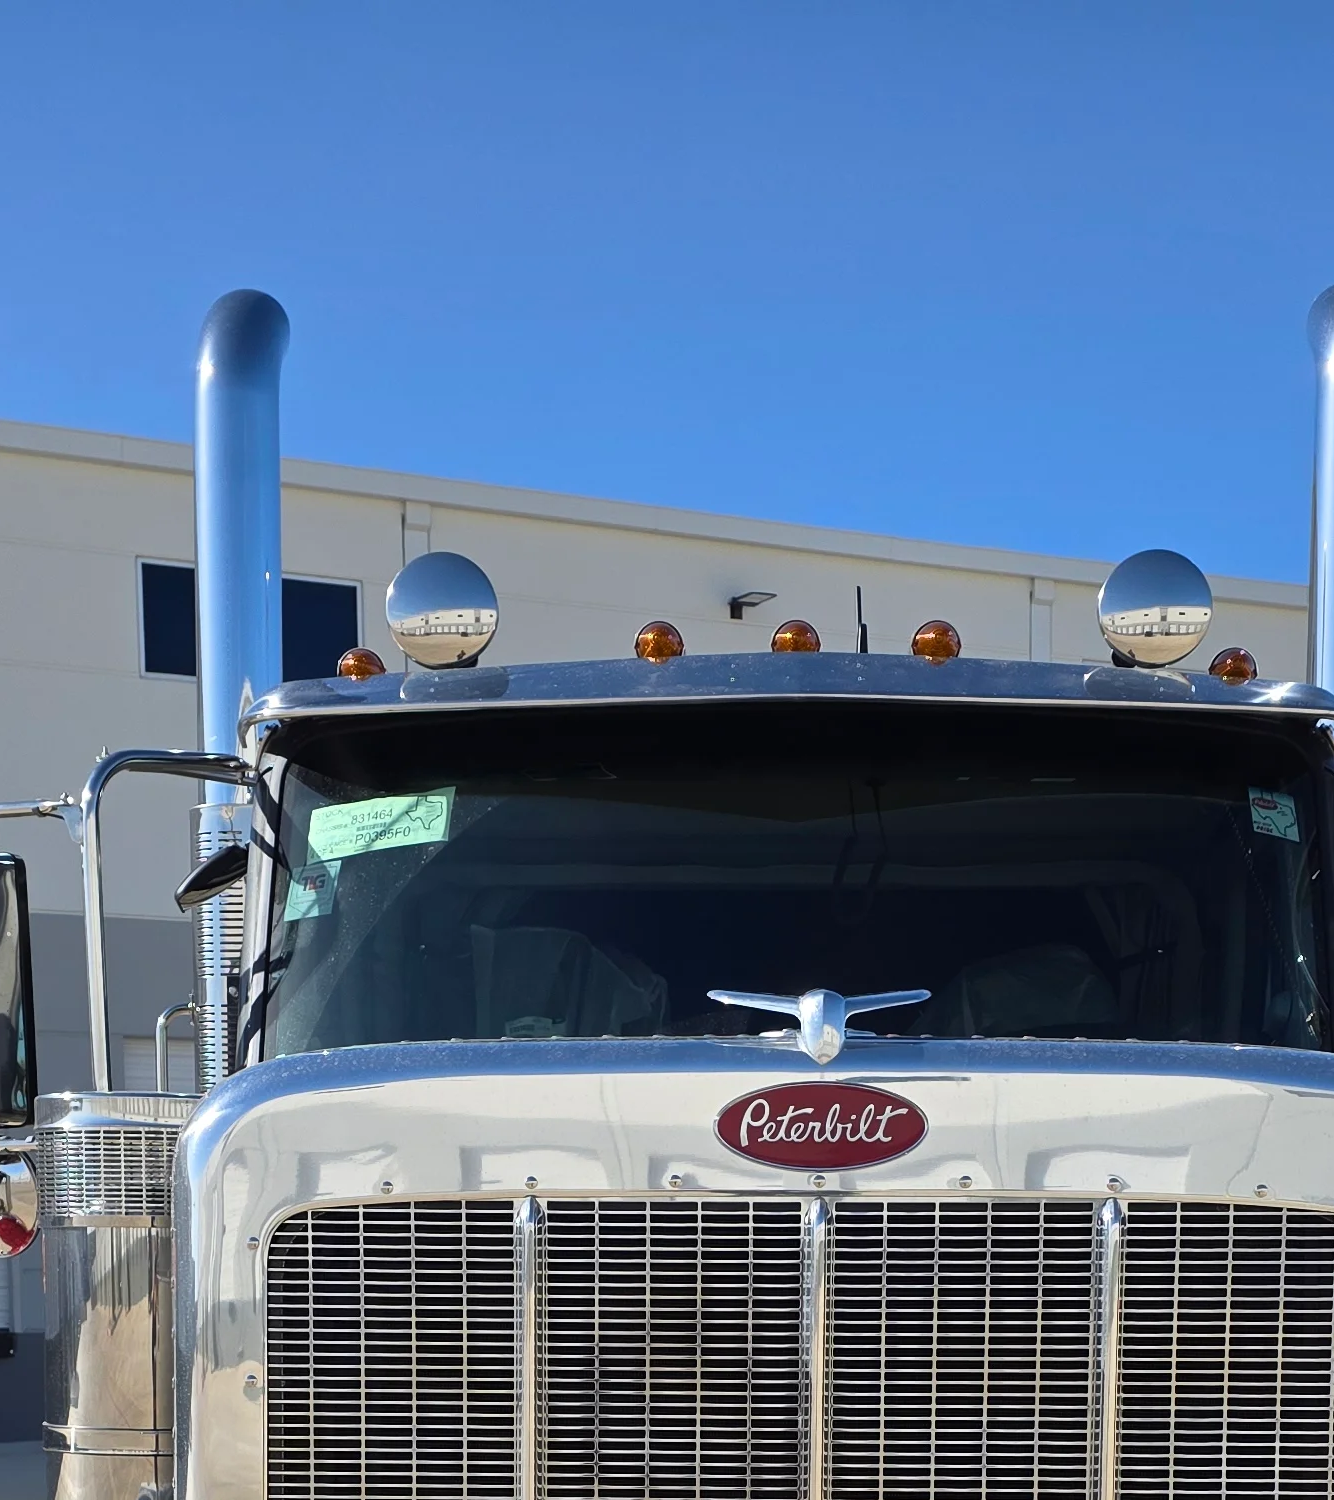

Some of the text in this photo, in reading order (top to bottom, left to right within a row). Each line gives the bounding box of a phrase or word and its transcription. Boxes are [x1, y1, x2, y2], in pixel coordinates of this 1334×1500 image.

[350, 808, 393, 825] 831464
[354, 825, 411, 845] P0395F0
[739, 1098, 909, 1147] Peterbilt
